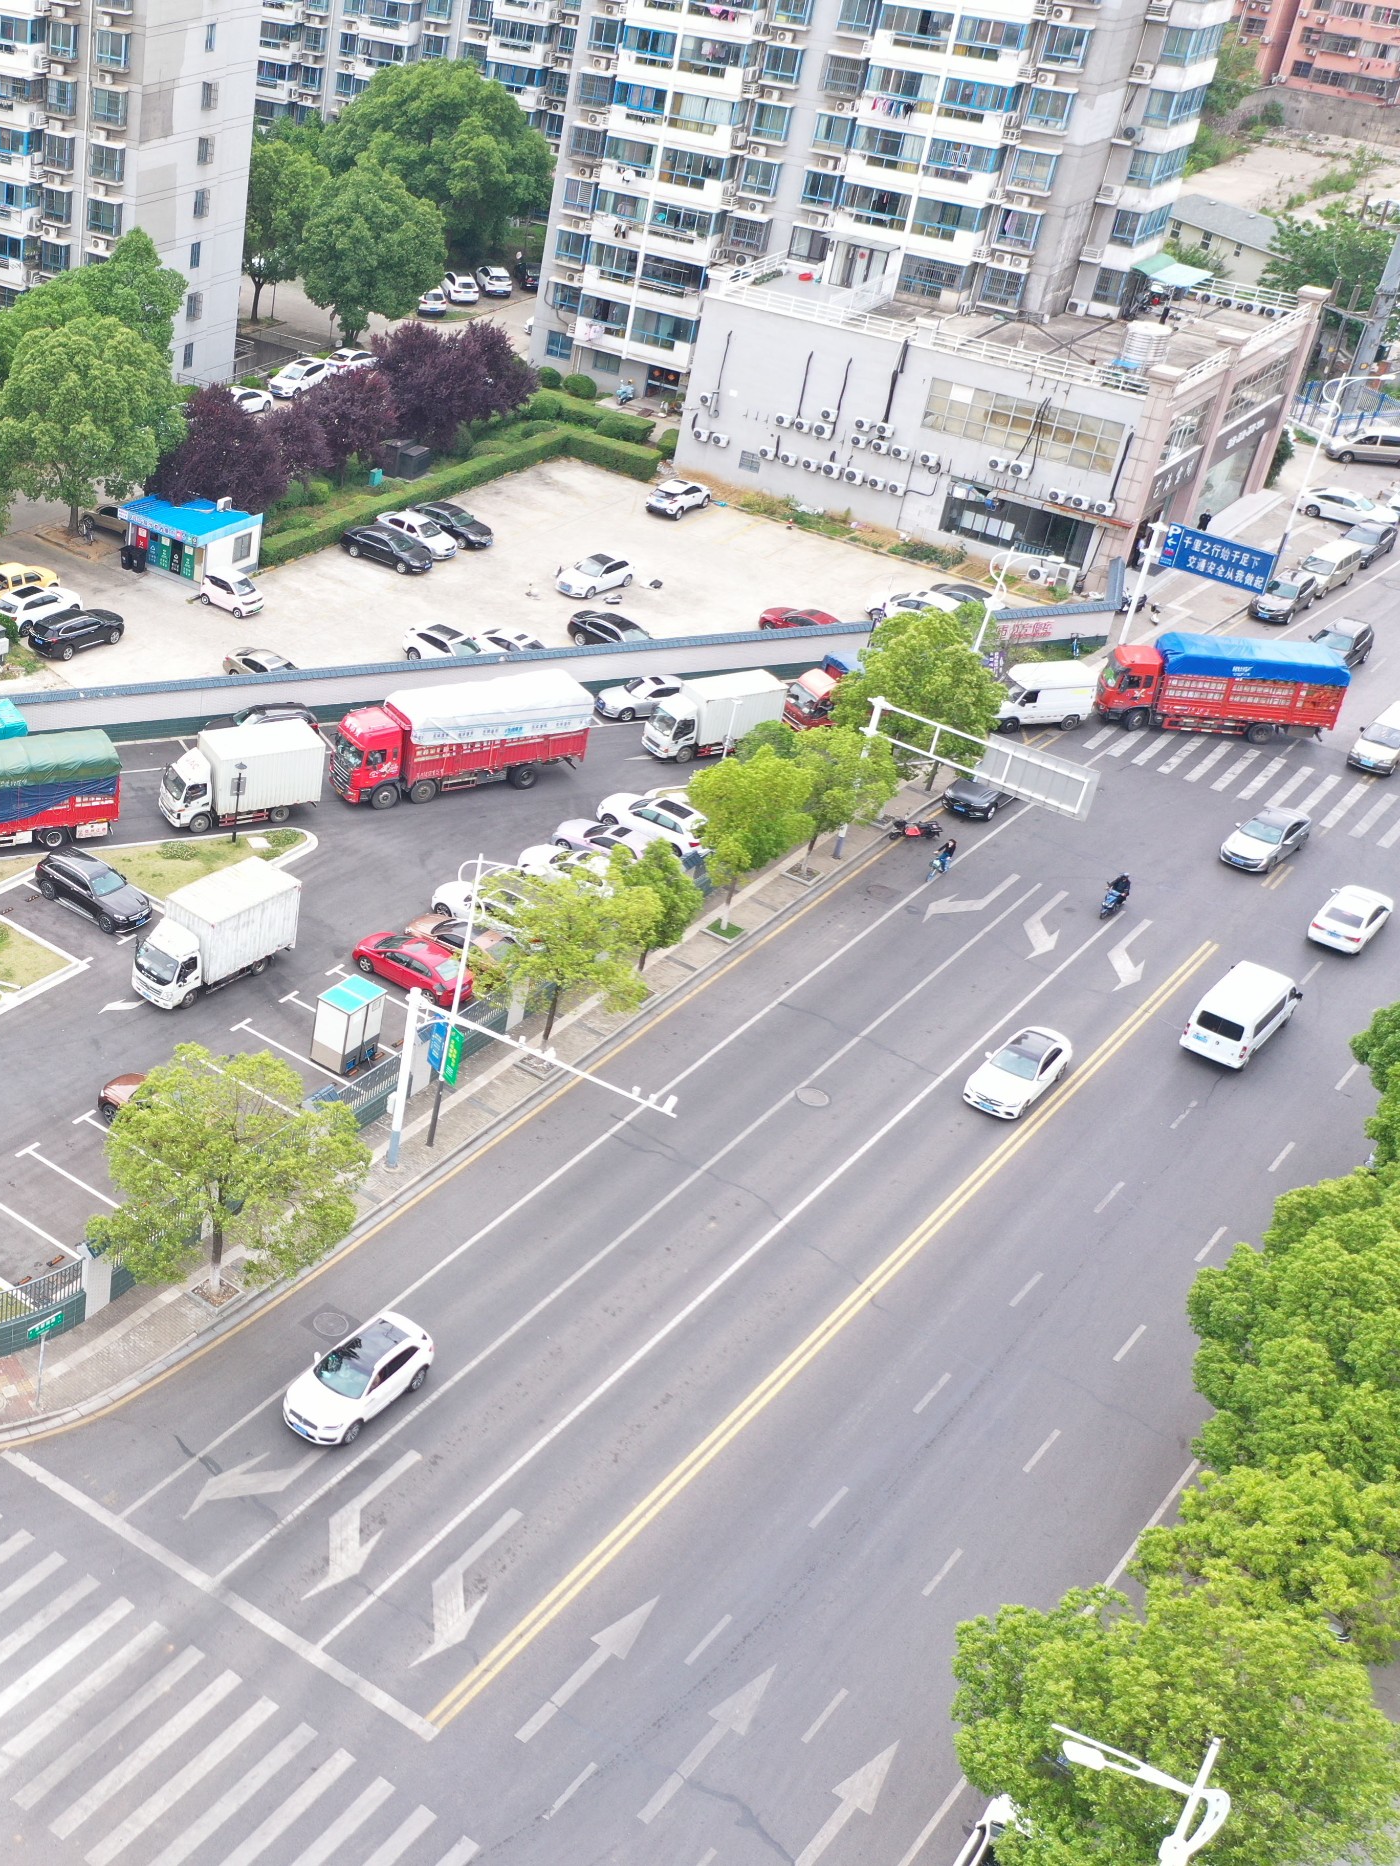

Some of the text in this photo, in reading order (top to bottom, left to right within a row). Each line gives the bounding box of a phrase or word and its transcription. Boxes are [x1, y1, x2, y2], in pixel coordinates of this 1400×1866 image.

[1167, 525, 1182, 537] P
[1183, 536, 1261, 569] 千里之行始于足下
[1186, 555, 1264, 590] 交通安全从我做起
